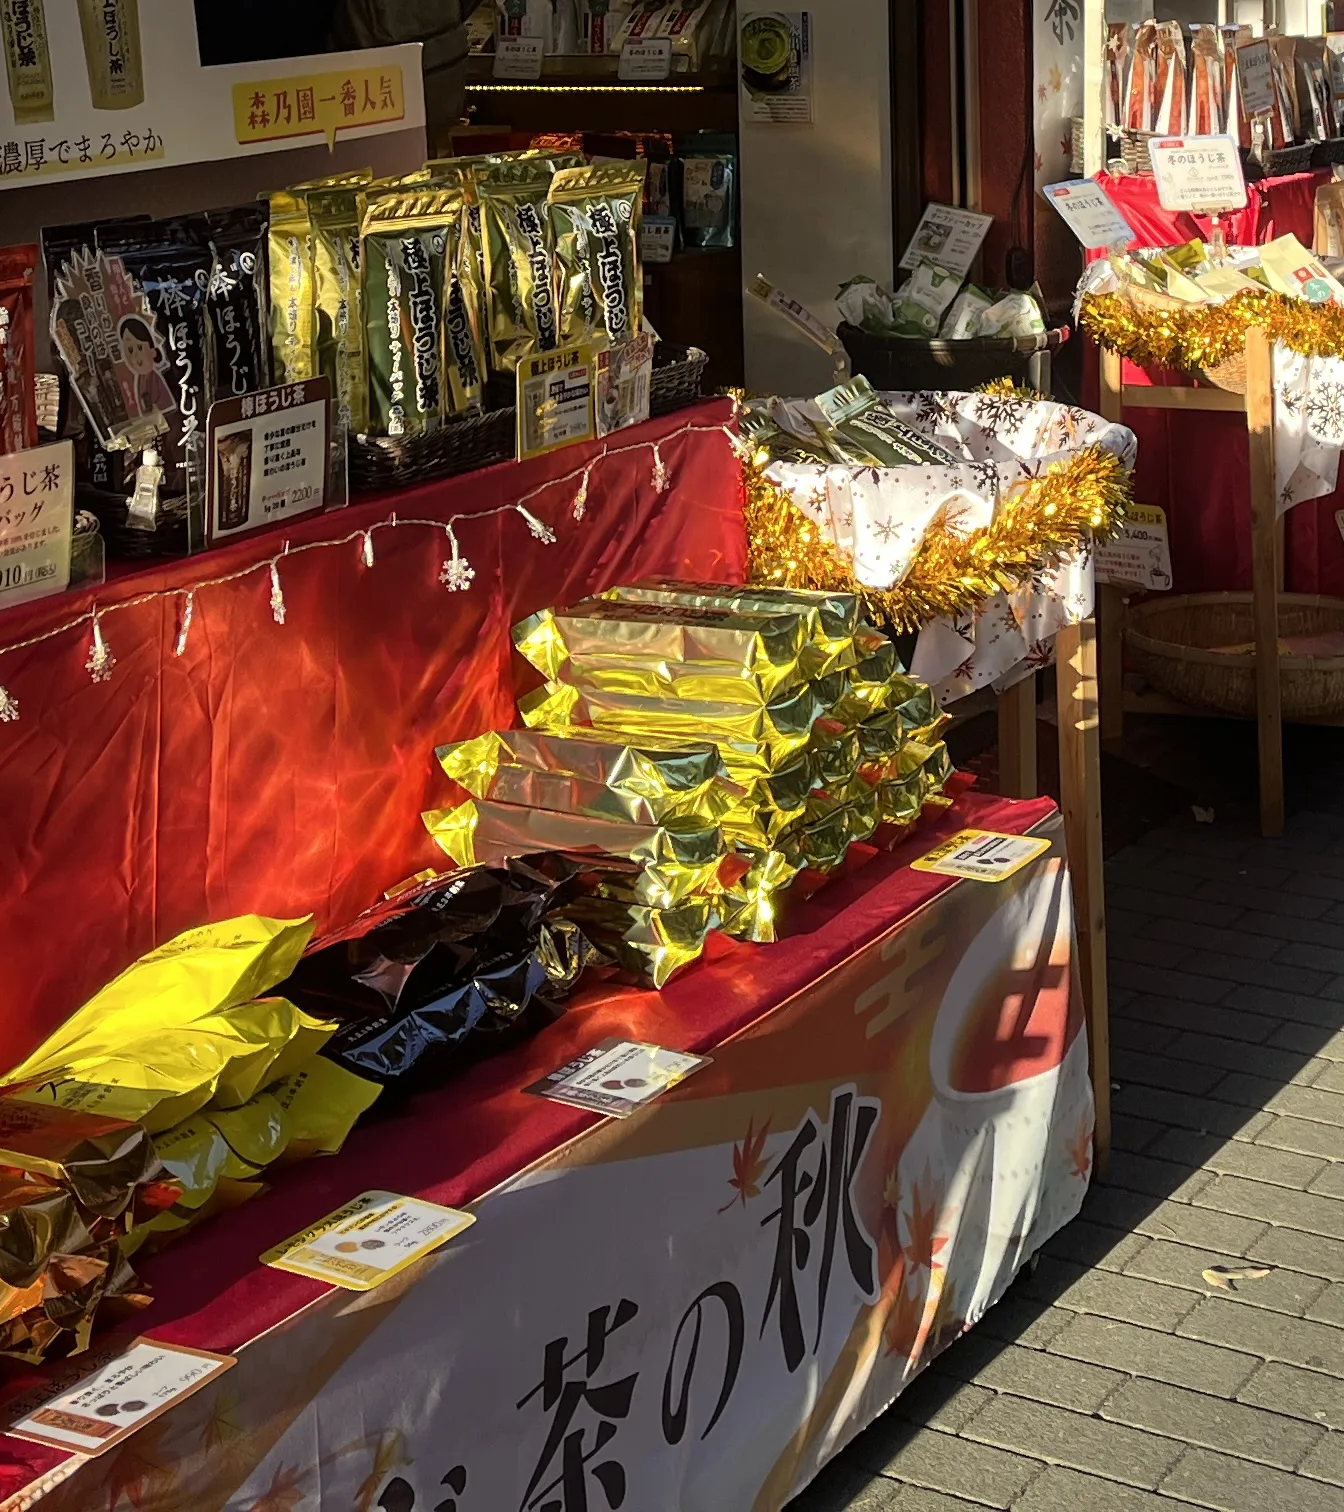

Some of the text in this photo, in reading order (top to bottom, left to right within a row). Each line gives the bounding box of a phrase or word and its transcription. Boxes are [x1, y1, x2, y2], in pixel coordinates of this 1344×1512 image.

[247, 76, 397, 130] 森乃園一番人気
